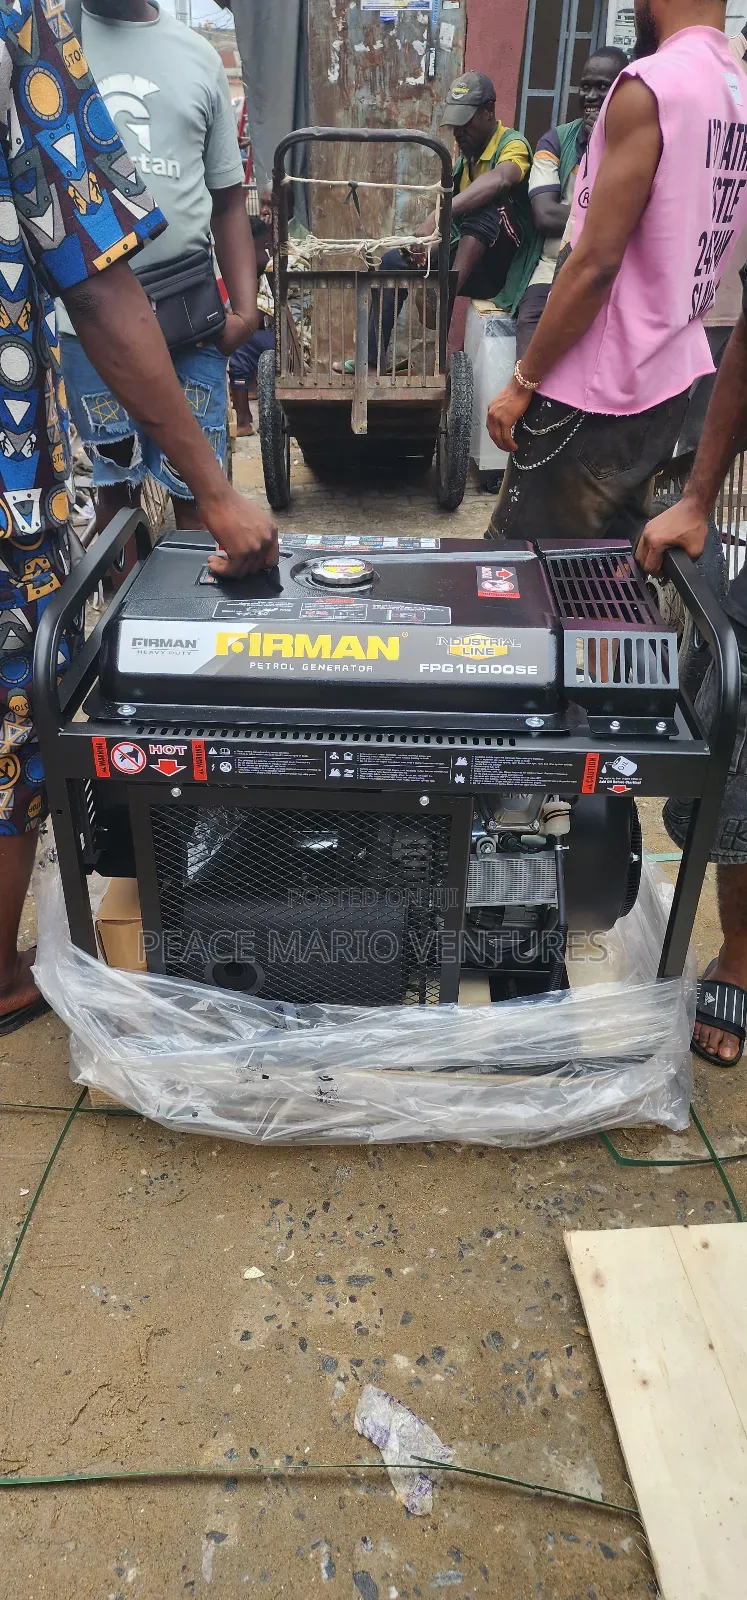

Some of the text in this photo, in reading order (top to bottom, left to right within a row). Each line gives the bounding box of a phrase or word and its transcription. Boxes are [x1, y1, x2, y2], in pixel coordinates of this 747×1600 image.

[132, 637, 197, 649] FIRMAN
[216, 632, 400, 660] FIRMAN
[436, 636, 522, 648] INDUSTRIAL
[462, 647, 495, 656] LINE
[249, 661, 374, 673] PETROL GENERATOR
[149, 744, 188, 756] HOT
[586, 757, 597, 783] CAUTION
[617, 761, 630, 771] OIL
